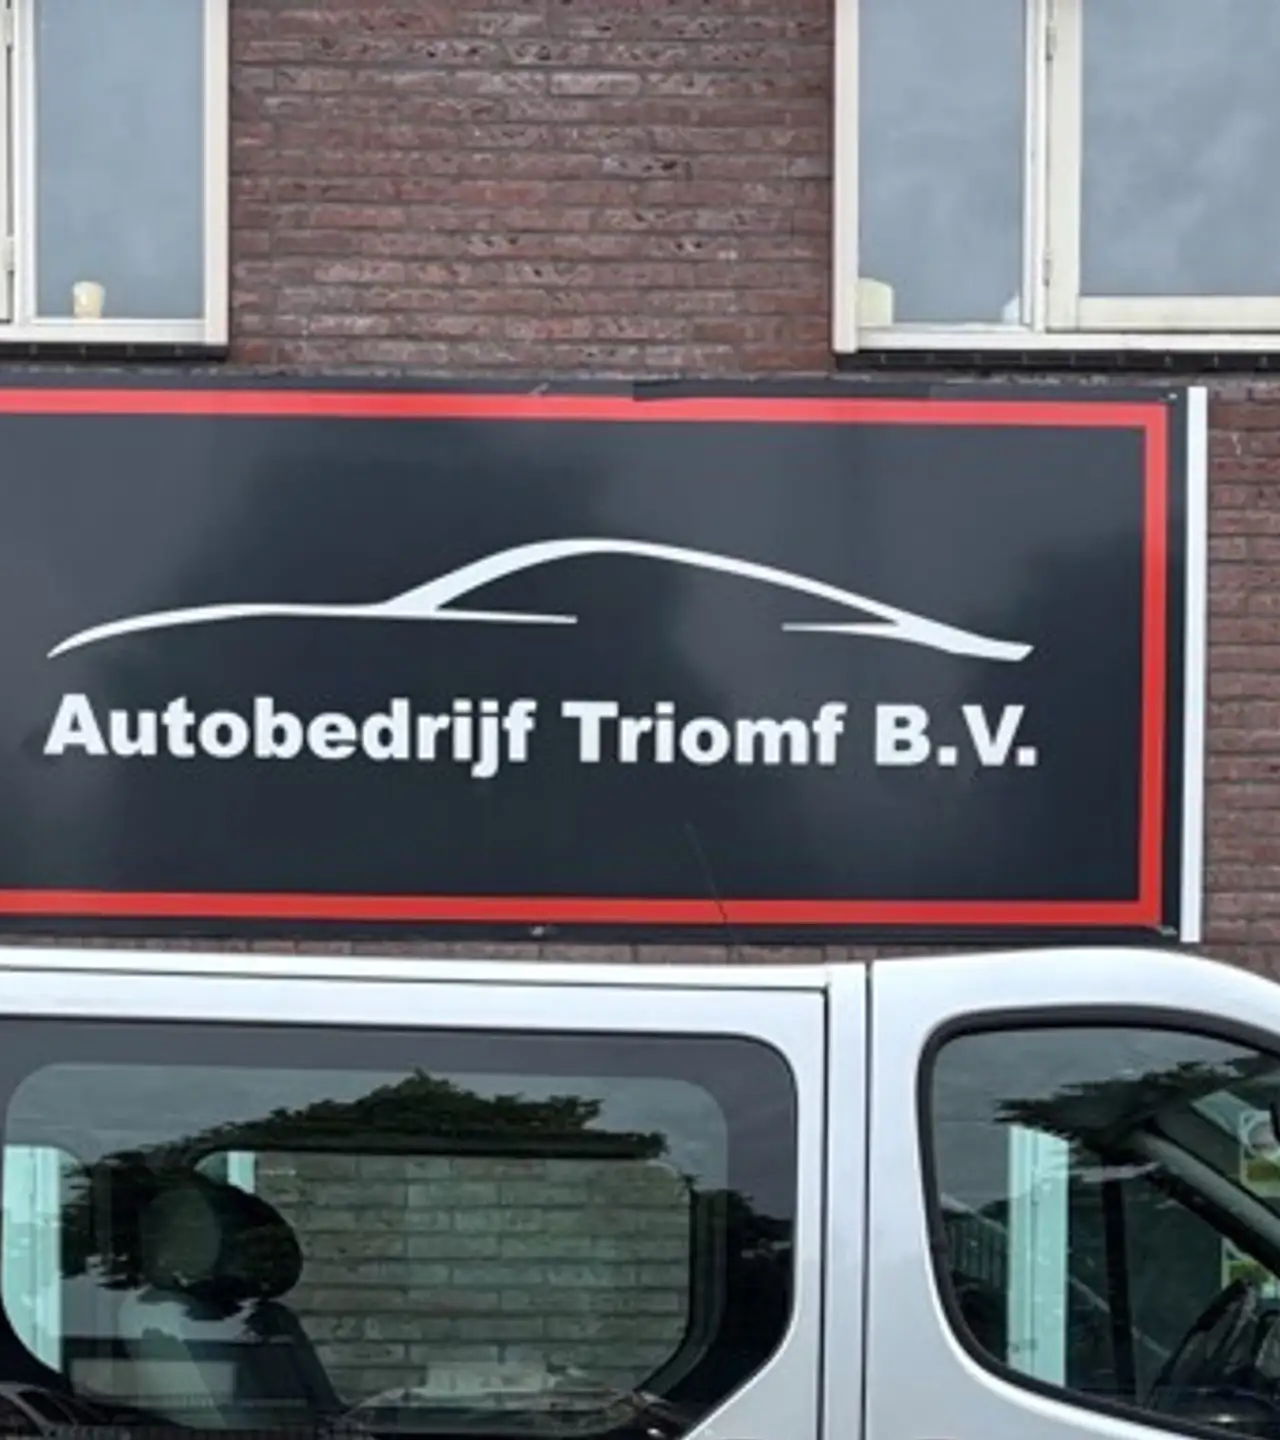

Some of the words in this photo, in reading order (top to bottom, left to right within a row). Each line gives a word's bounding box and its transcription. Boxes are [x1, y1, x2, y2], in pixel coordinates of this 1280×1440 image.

[43, 692, 537, 778] Autobedrijf
[562, 700, 847, 765] Triomf
[875, 704, 1039, 768] B.V.
